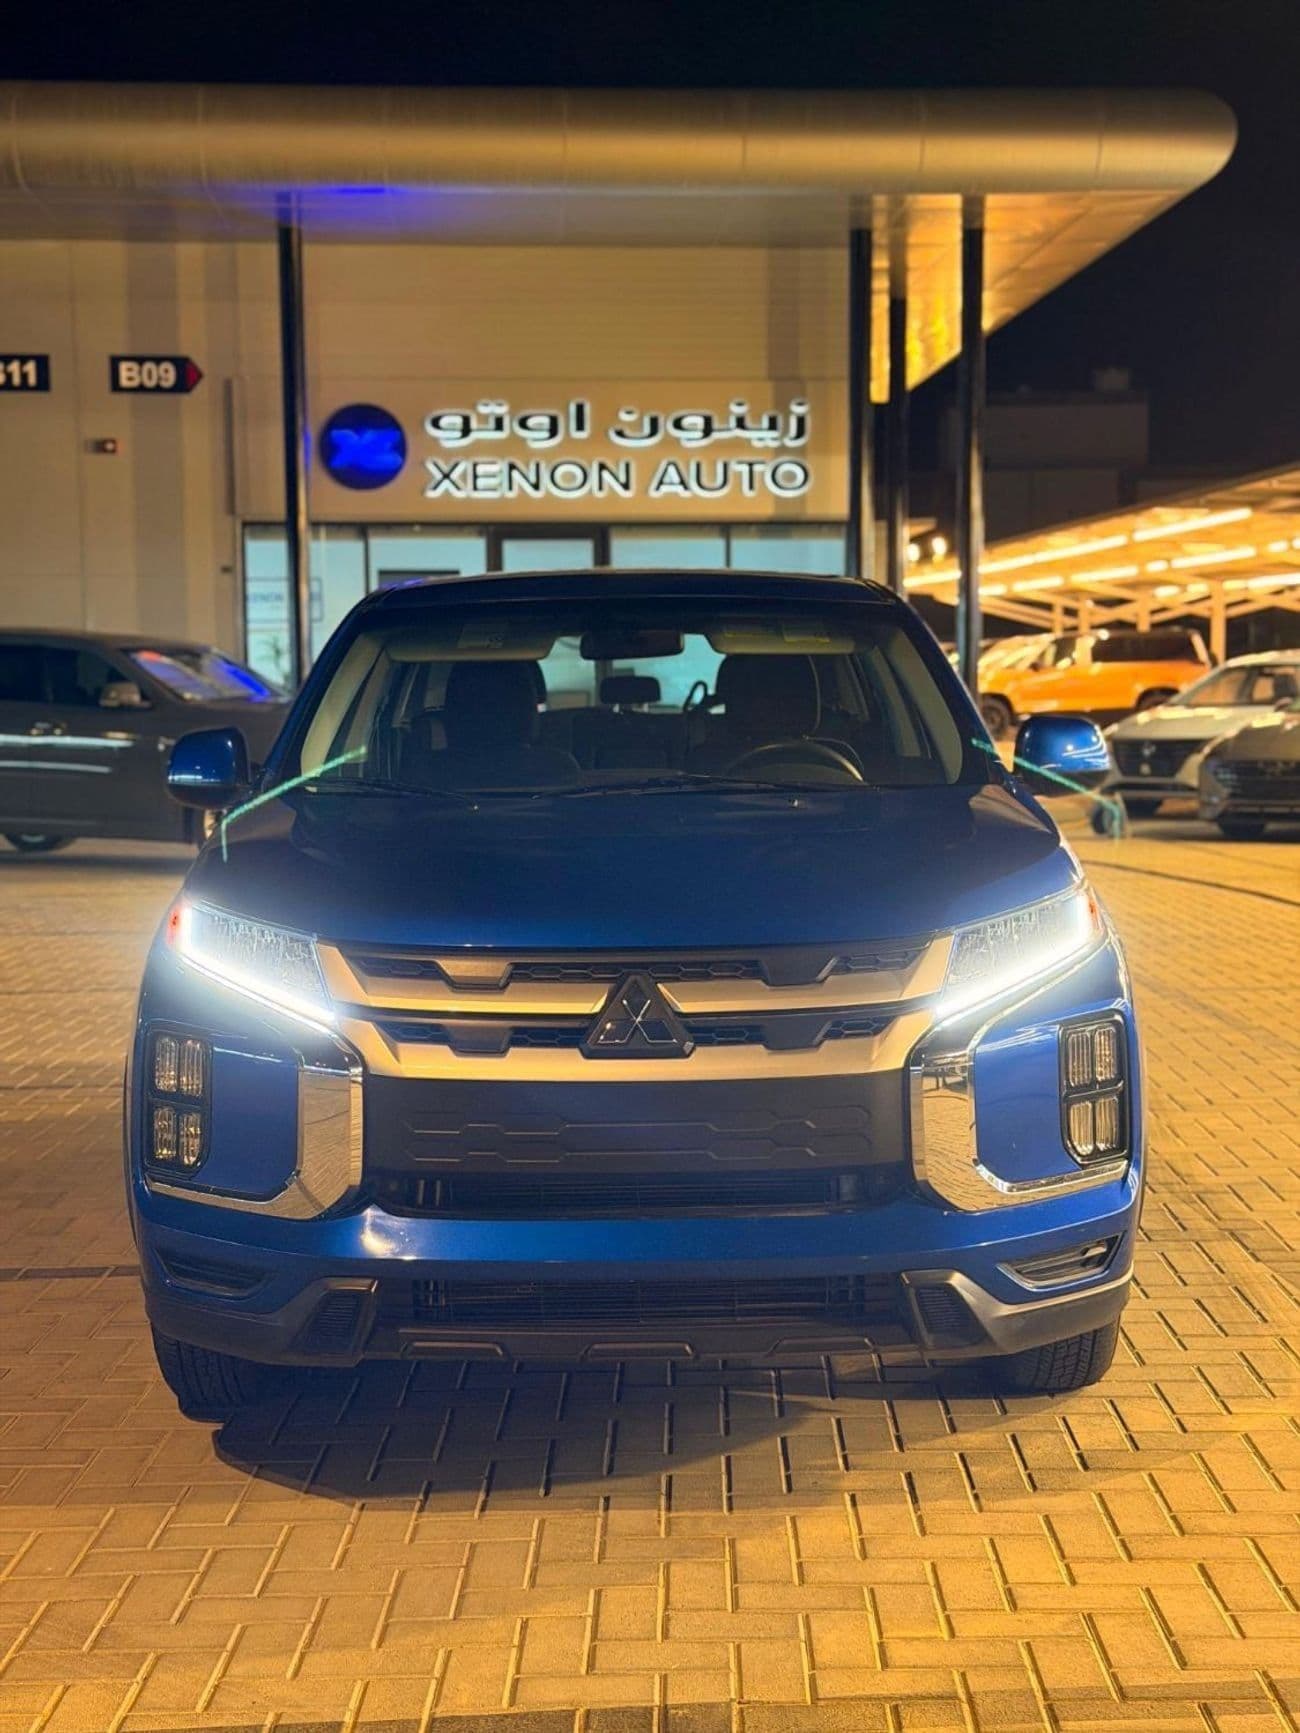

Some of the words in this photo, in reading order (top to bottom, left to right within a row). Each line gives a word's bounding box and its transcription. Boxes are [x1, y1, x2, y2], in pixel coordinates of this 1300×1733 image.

[0, 360, 37, 387] 11
[118, 361, 177, 388] B09
[426, 400, 590, 448] اوتو
[608, 400, 810, 448] زينون
[425, 458, 634, 498] XENON
[649, 458, 811, 498] AUTO
